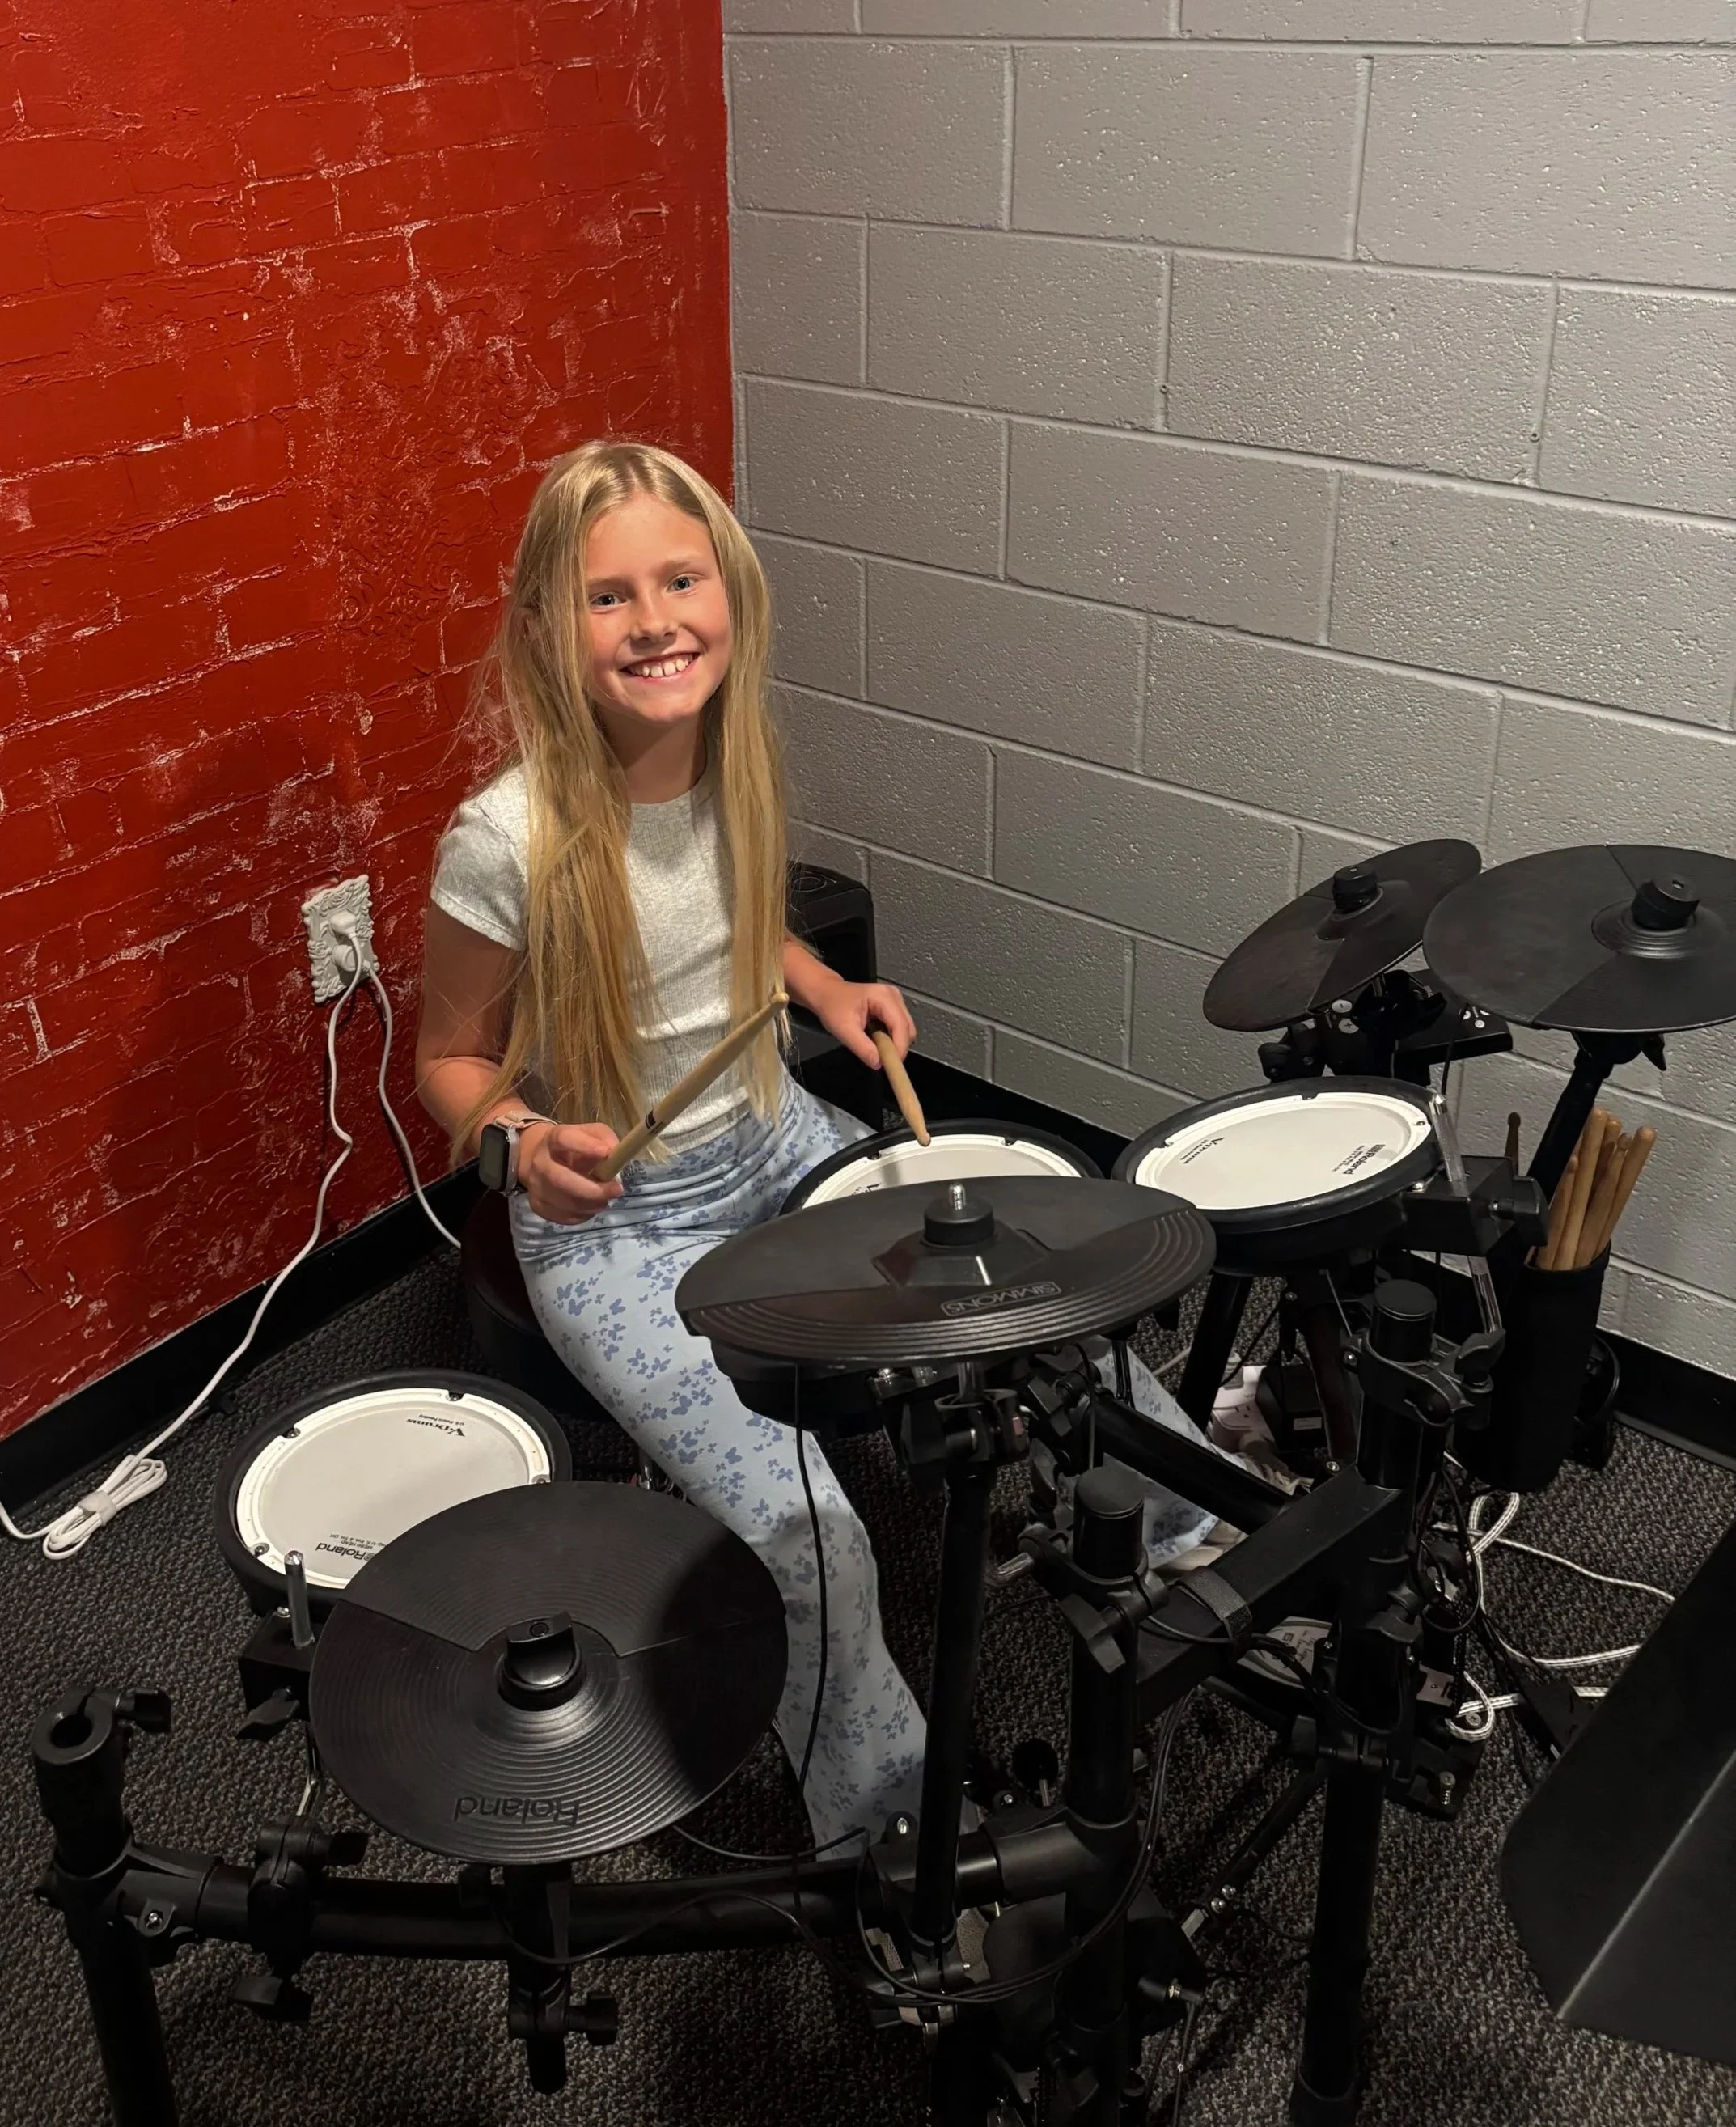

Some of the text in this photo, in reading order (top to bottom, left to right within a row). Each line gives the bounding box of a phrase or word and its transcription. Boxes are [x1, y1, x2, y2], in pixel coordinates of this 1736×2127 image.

[1343, 1152, 1375, 1174] Roland
[946, 1283, 1055, 1314] SIMMONS
[406, 1418, 466, 1437] V-Drums
[315, 1542, 366, 1561] Roland
[455, 1796, 580, 1827] Roland
